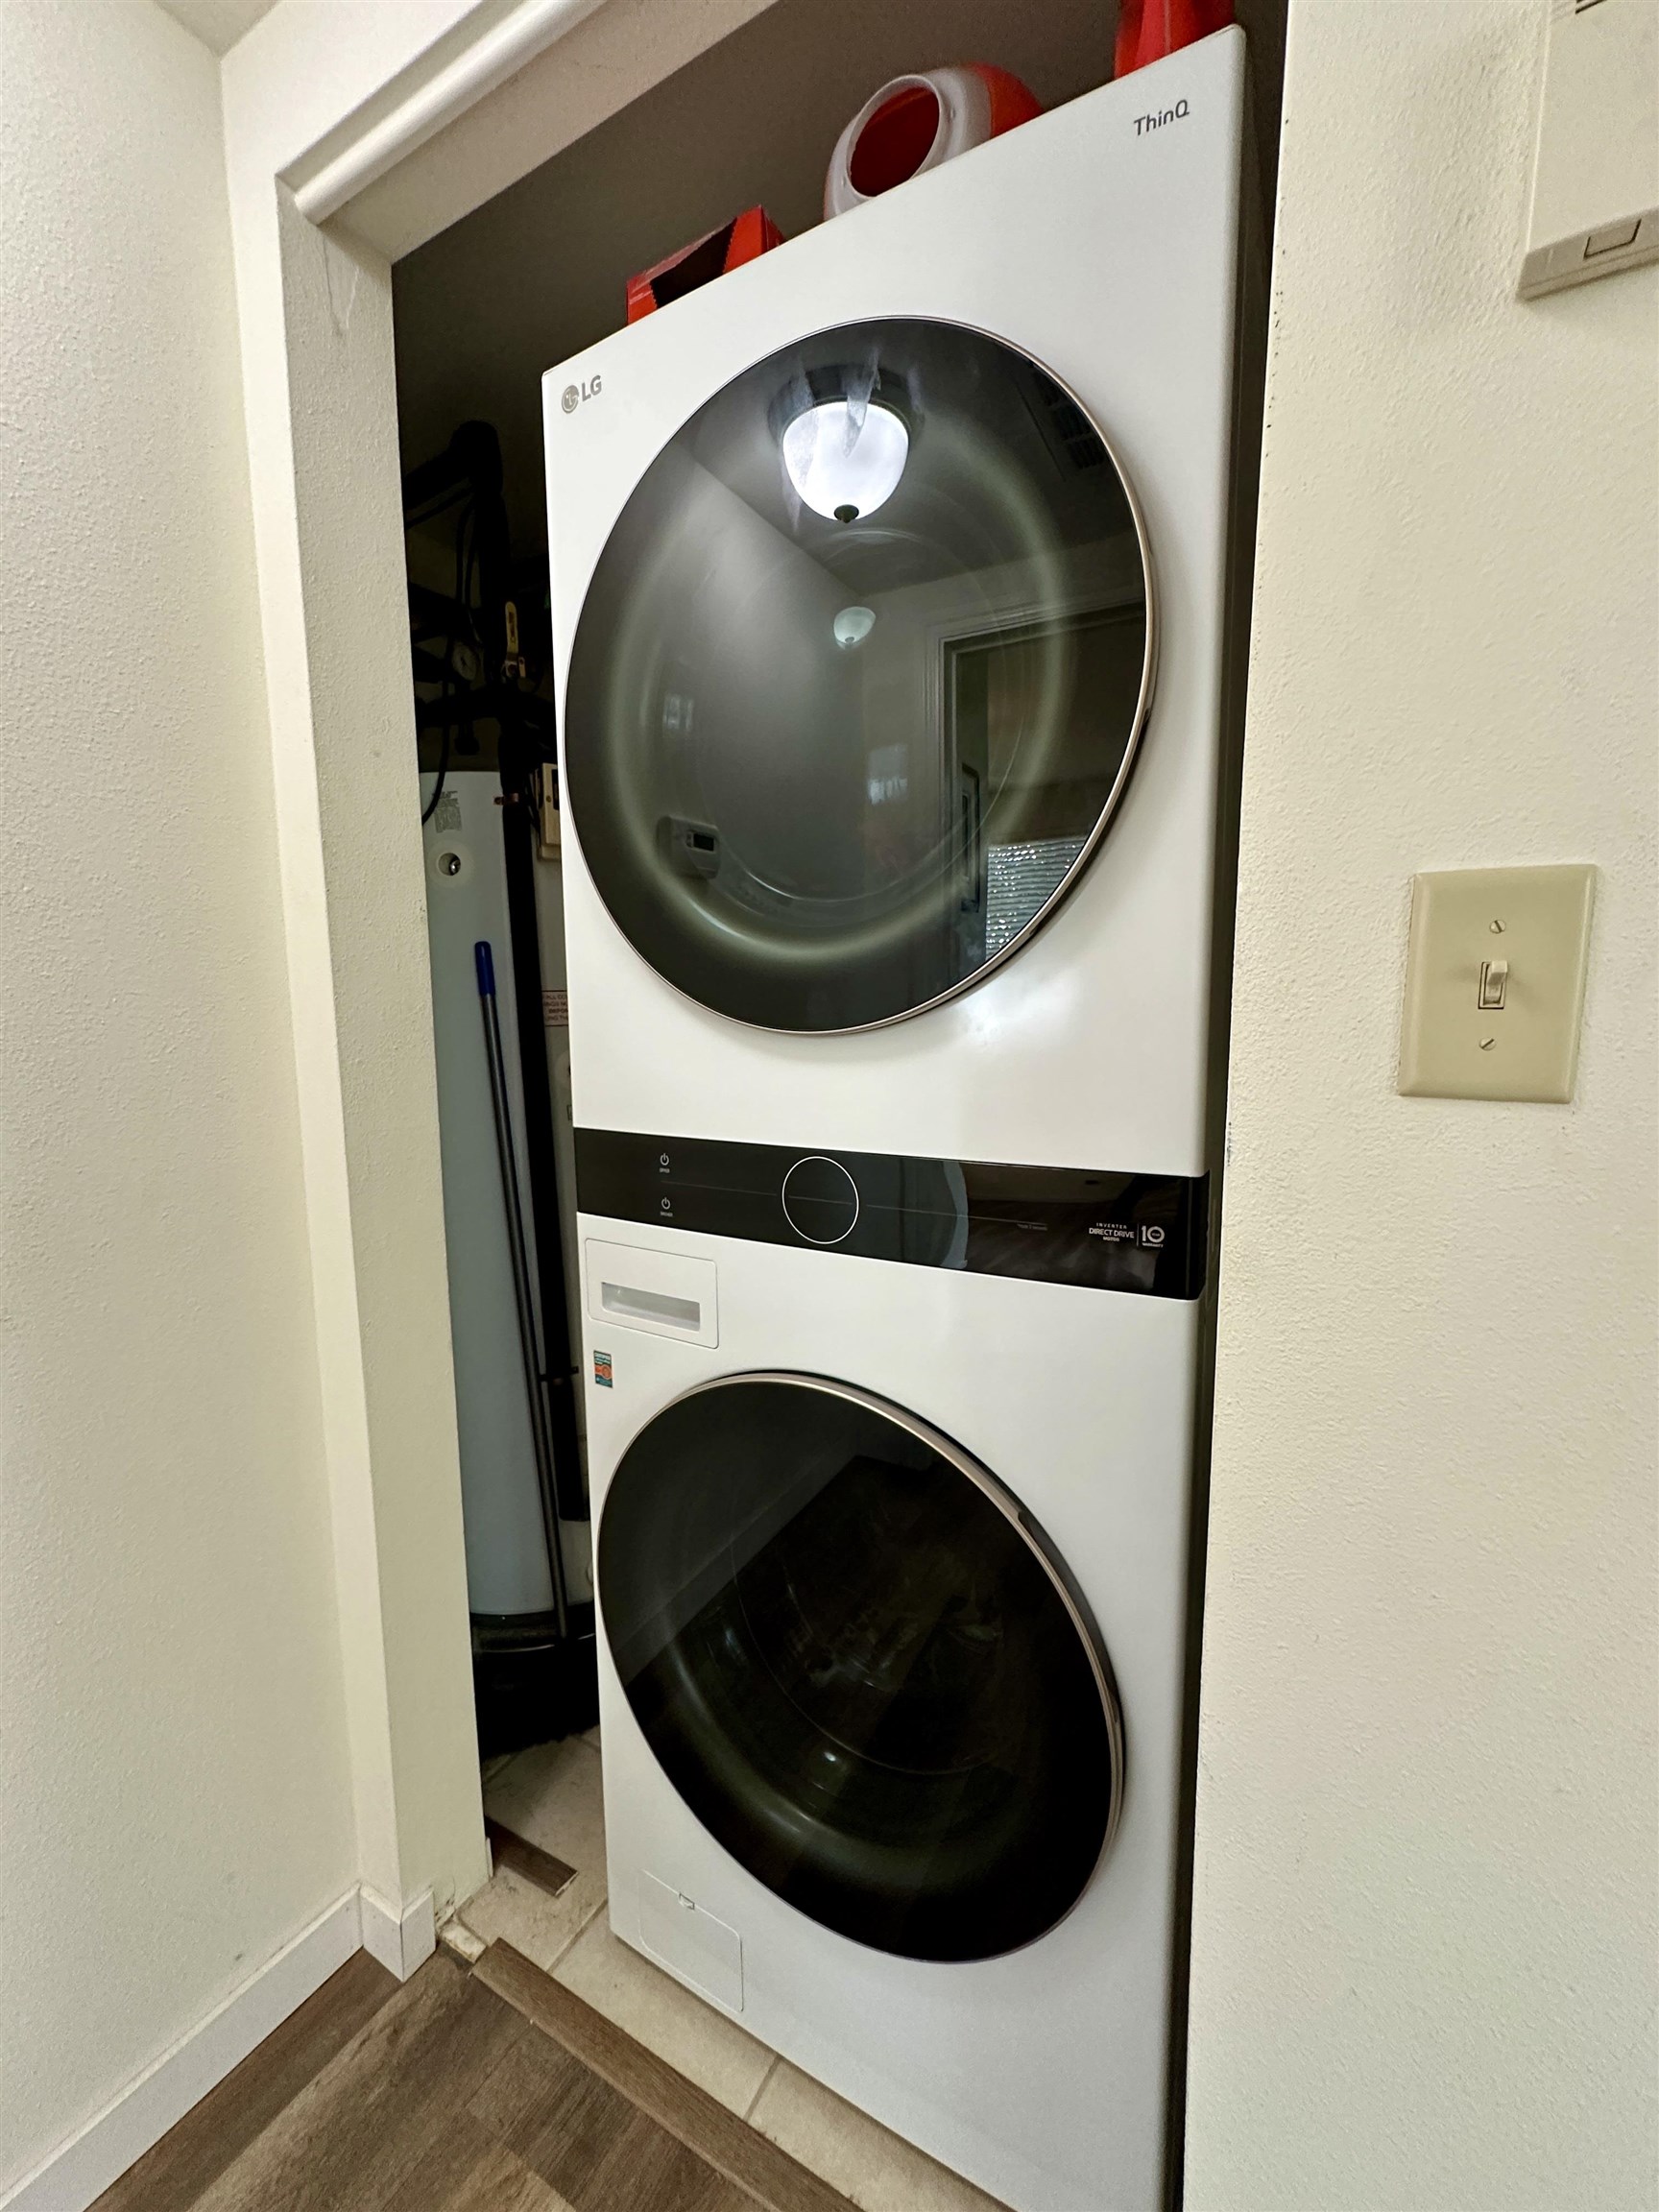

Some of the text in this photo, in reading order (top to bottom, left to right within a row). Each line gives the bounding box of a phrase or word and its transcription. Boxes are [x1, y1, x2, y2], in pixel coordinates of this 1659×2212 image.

[1134, 99, 1190, 135] ThinQ
[582, 374, 602, 401] LG
[1114, 1230, 1135, 1238] DRIVE
[1142, 1225, 1166, 1243] 10
